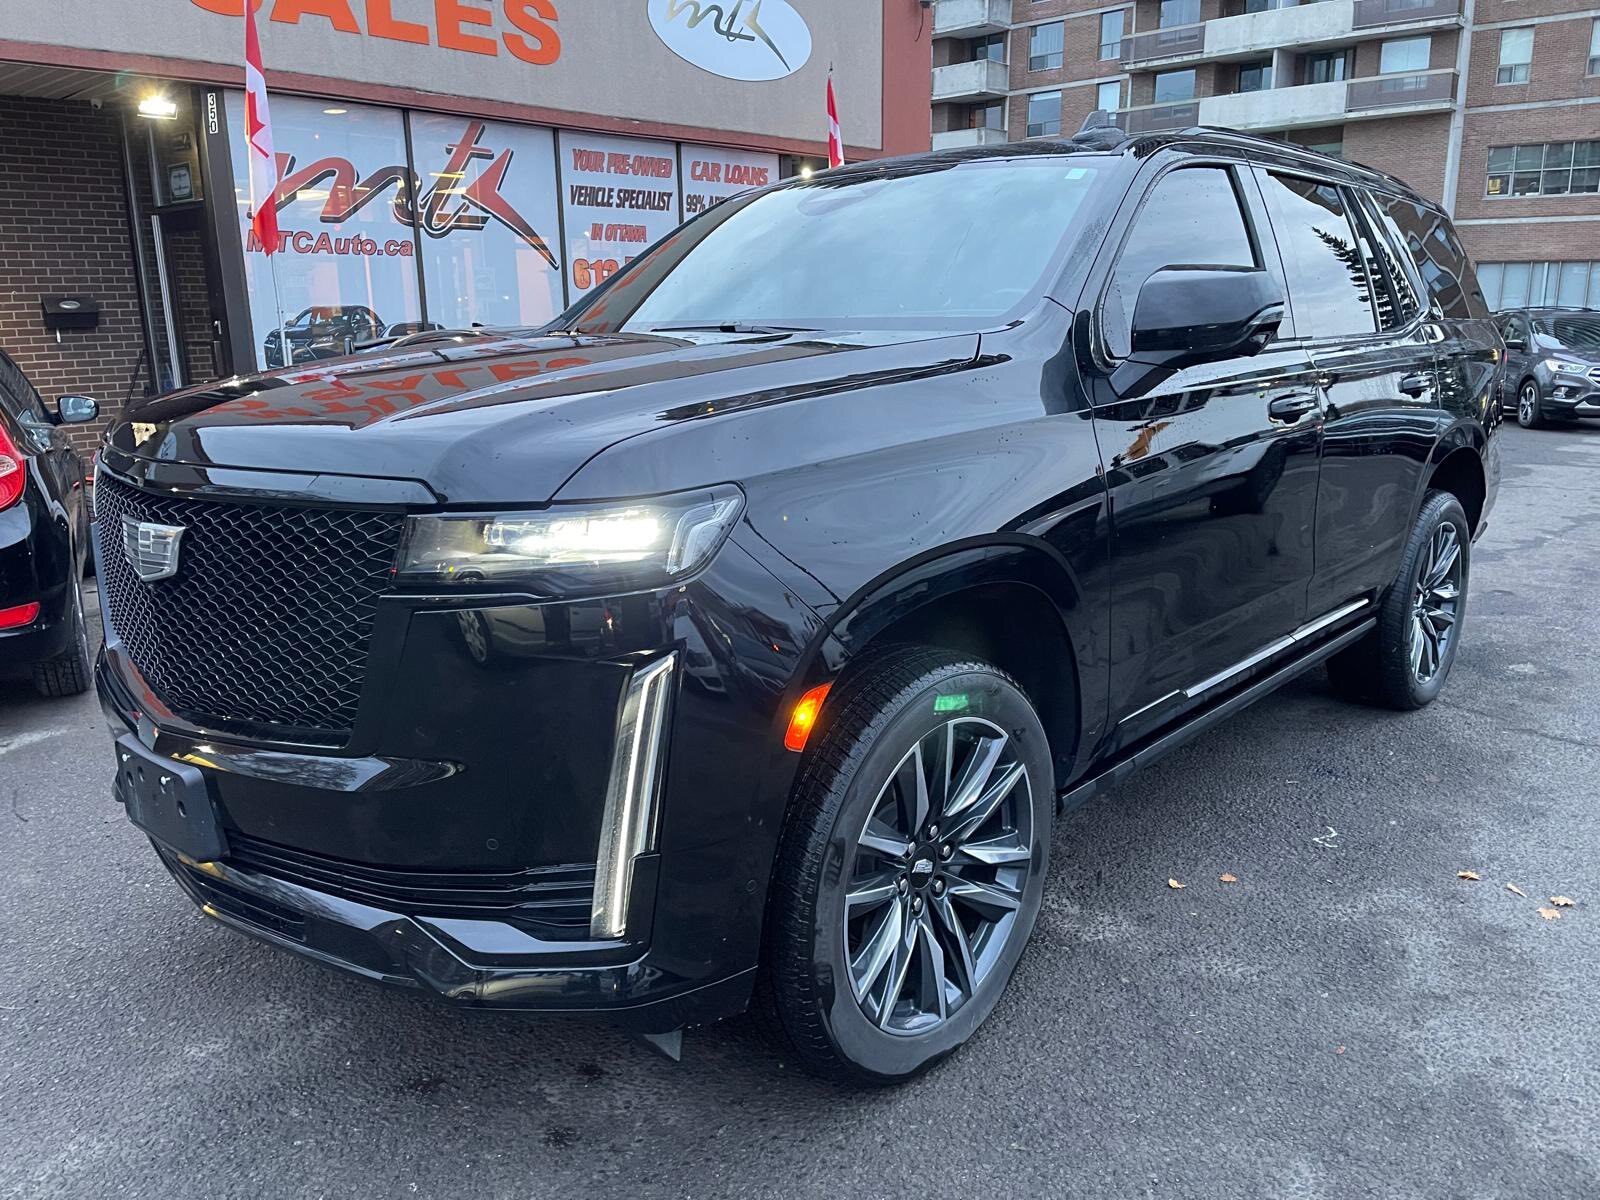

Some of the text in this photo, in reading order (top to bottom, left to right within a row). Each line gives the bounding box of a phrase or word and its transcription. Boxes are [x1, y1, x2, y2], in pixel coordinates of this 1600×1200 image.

[190, 0, 562, 66] LES
[207, 93, 218, 133] 350
[572, 148, 673, 179] YOUR PRE-OWNED
[690, 160, 769, 187] CAR LOANS
[570, 184, 673, 211] VEHICLE SPECIALIST
[686, 194, 706, 213] 99%
[591, 222, 648, 243] IN OTTAWA
